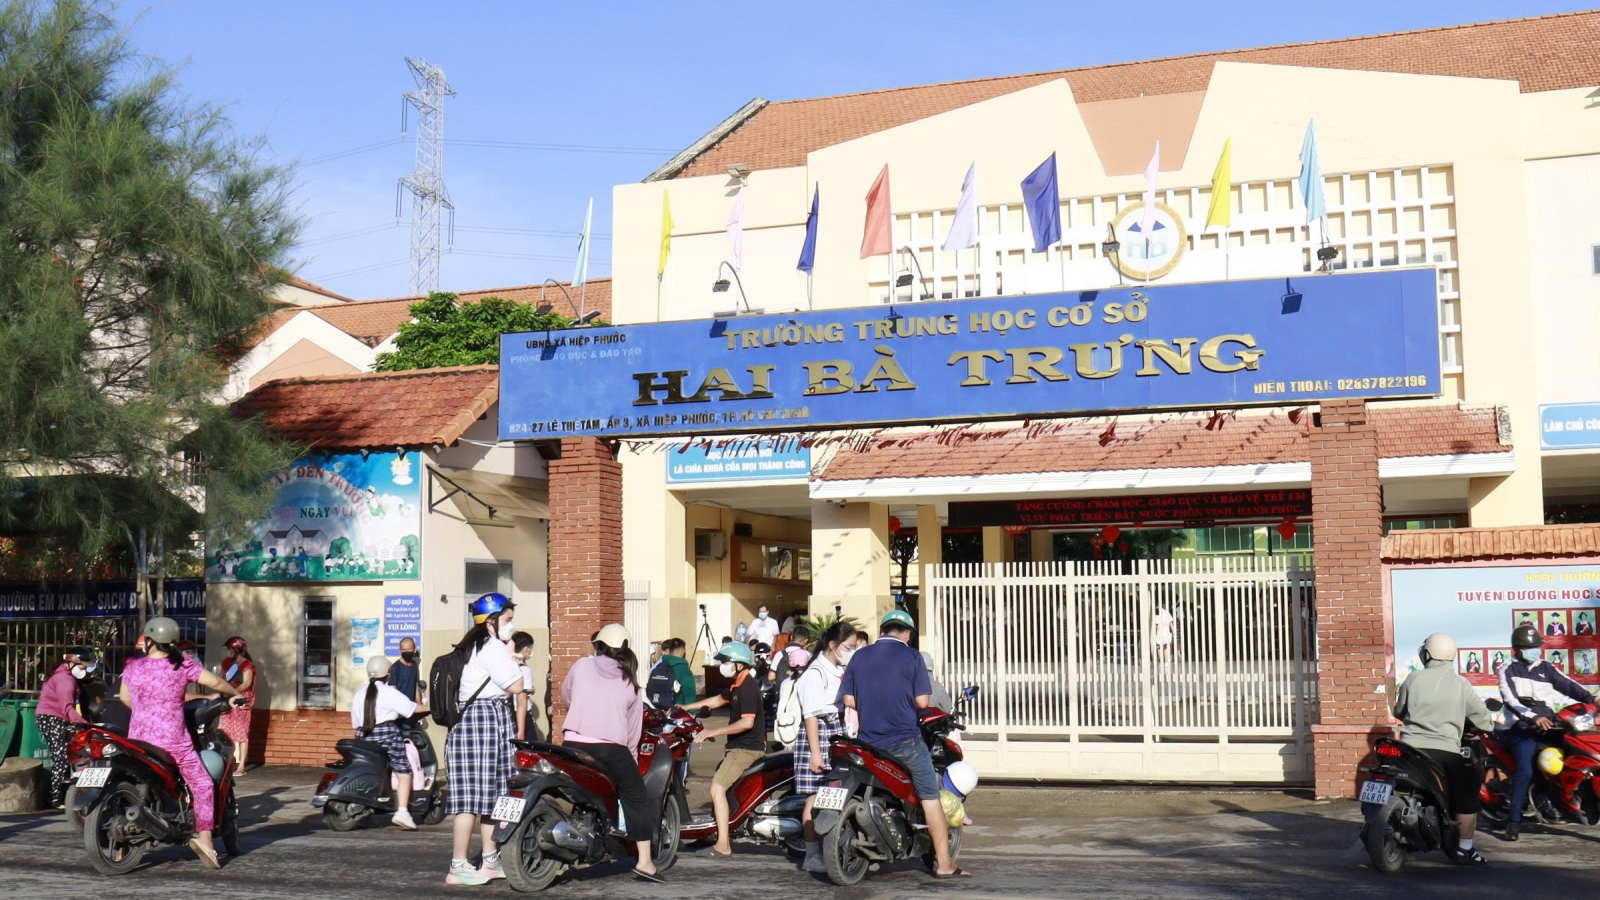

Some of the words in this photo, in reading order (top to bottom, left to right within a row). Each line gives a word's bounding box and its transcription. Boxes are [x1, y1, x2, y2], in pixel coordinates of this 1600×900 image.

[722, 319, 844, 350] TRƯỜNG
[853, 314, 958, 341] TRUNG
[969, 308, 1036, 335] HỌC
[1048, 301, 1094, 327] CƠ
[1102, 292, 1149, 323] SỞ
[526, 338, 550, 349] UBND
[554, 336, 567, 347] XÃ
[569, 335, 590, 348] HIỆP
[594, 331, 627, 345] PHƯỚC
[632, 364, 775, 406] HAI
[802, 344, 917, 396] BÀ
[947, 334, 1265, 387] TRƯNG
[1254, 380, 1285, 395] ĐIỆN
[1337, 375, 1427, 391] 02837822196
[547, 419, 558, 432] LÊ
[636, 415, 651, 427] XÃ
[654, 413, 677, 428] HIỆP
[1544, 419, 1564, 432] LÀM
[1566, 417, 1584, 431] CHỦ
[296, 461, 325, 480] ĐẾN
[674, 464, 683, 474] LÀ
[704, 462, 724, 473] KHOÁ
[725, 460, 740, 472] CỦA
[742, 461, 757, 473] MỌI
[758, 459, 783, 470] THÀNH
[785, 458, 806, 469] CÔNG
[1288, 492, 1307, 502] EM
[300, 503, 331, 519] NGÀY
[334, 506, 354, 517] VUI
[38, 593, 55, 610] EM
[58, 593, 86, 611] XANH
[97, 591, 127, 613] SẠCH
[1457, 589, 1503, 602] TUYÊN
[1507, 589, 1557, 601] DƯƠNG
[1562, 589, 1591, 602] HỌC
[400, 622, 417, 631] LÒNG
[820, 787, 844, 799] 59-Z1
[499, 797, 521, 810] 59-Z1
